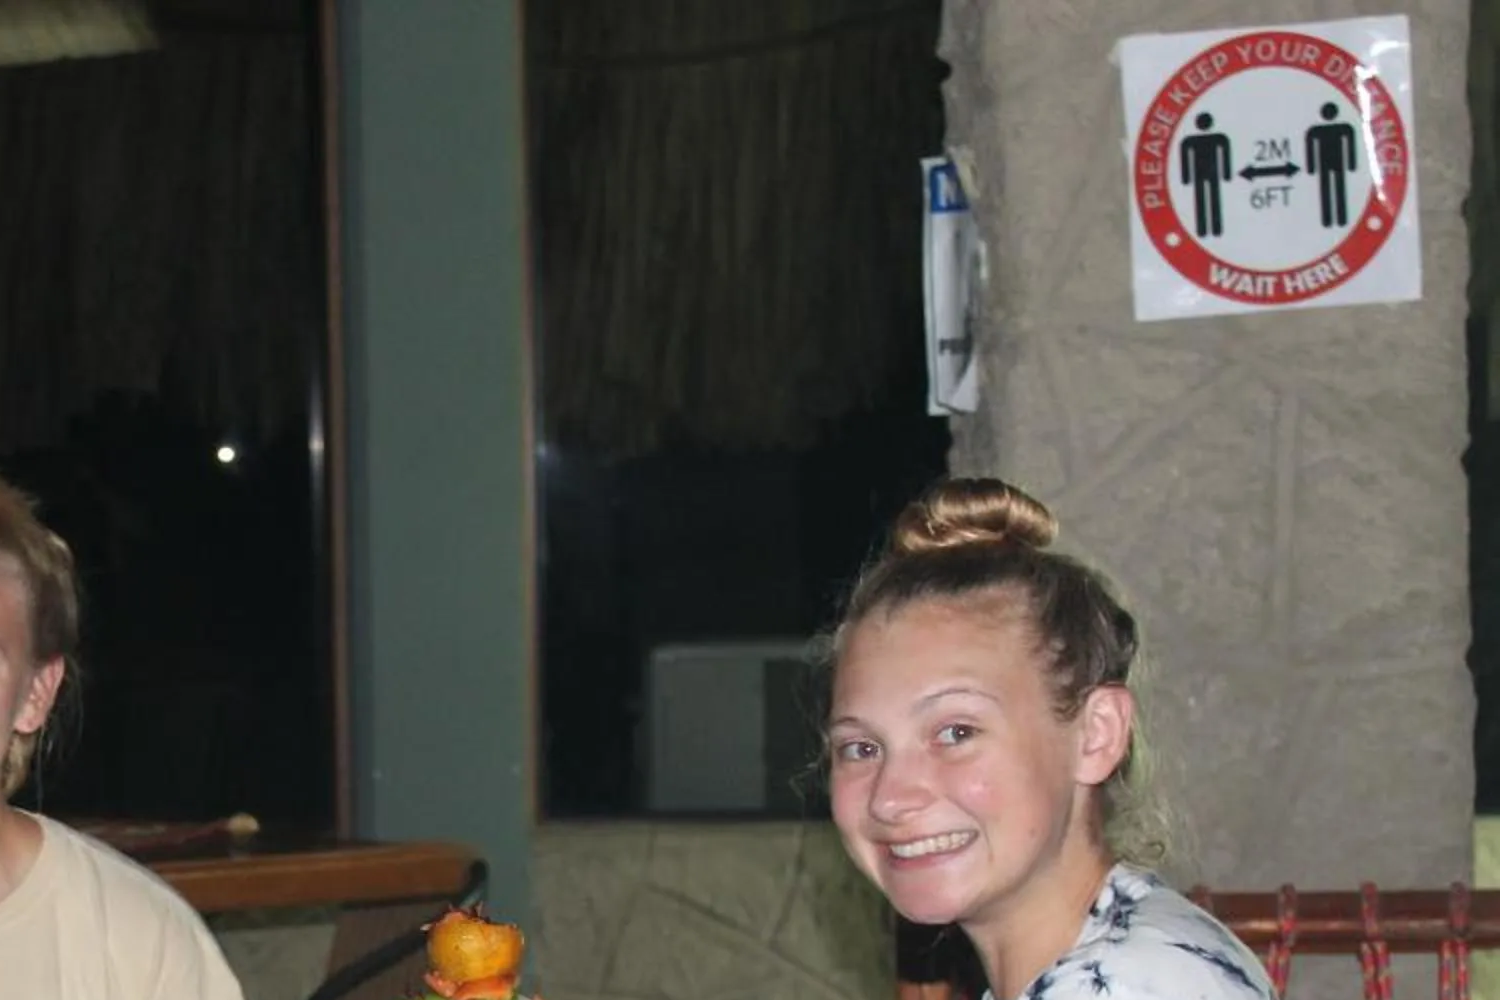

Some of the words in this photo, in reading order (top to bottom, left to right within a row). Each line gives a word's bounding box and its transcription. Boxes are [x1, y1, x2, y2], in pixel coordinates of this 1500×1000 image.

[1141, 105, 1178, 209] PLEASE
[1168, 53, 1228, 107] KEEP
[1236, 39, 1321, 66] YOUR
[1254, 138, 1291, 162] 2M
[1250, 186, 1293, 209] 6FT
[1209, 262, 1277, 297] WAIT
[1284, 253, 1349, 294] HERE
